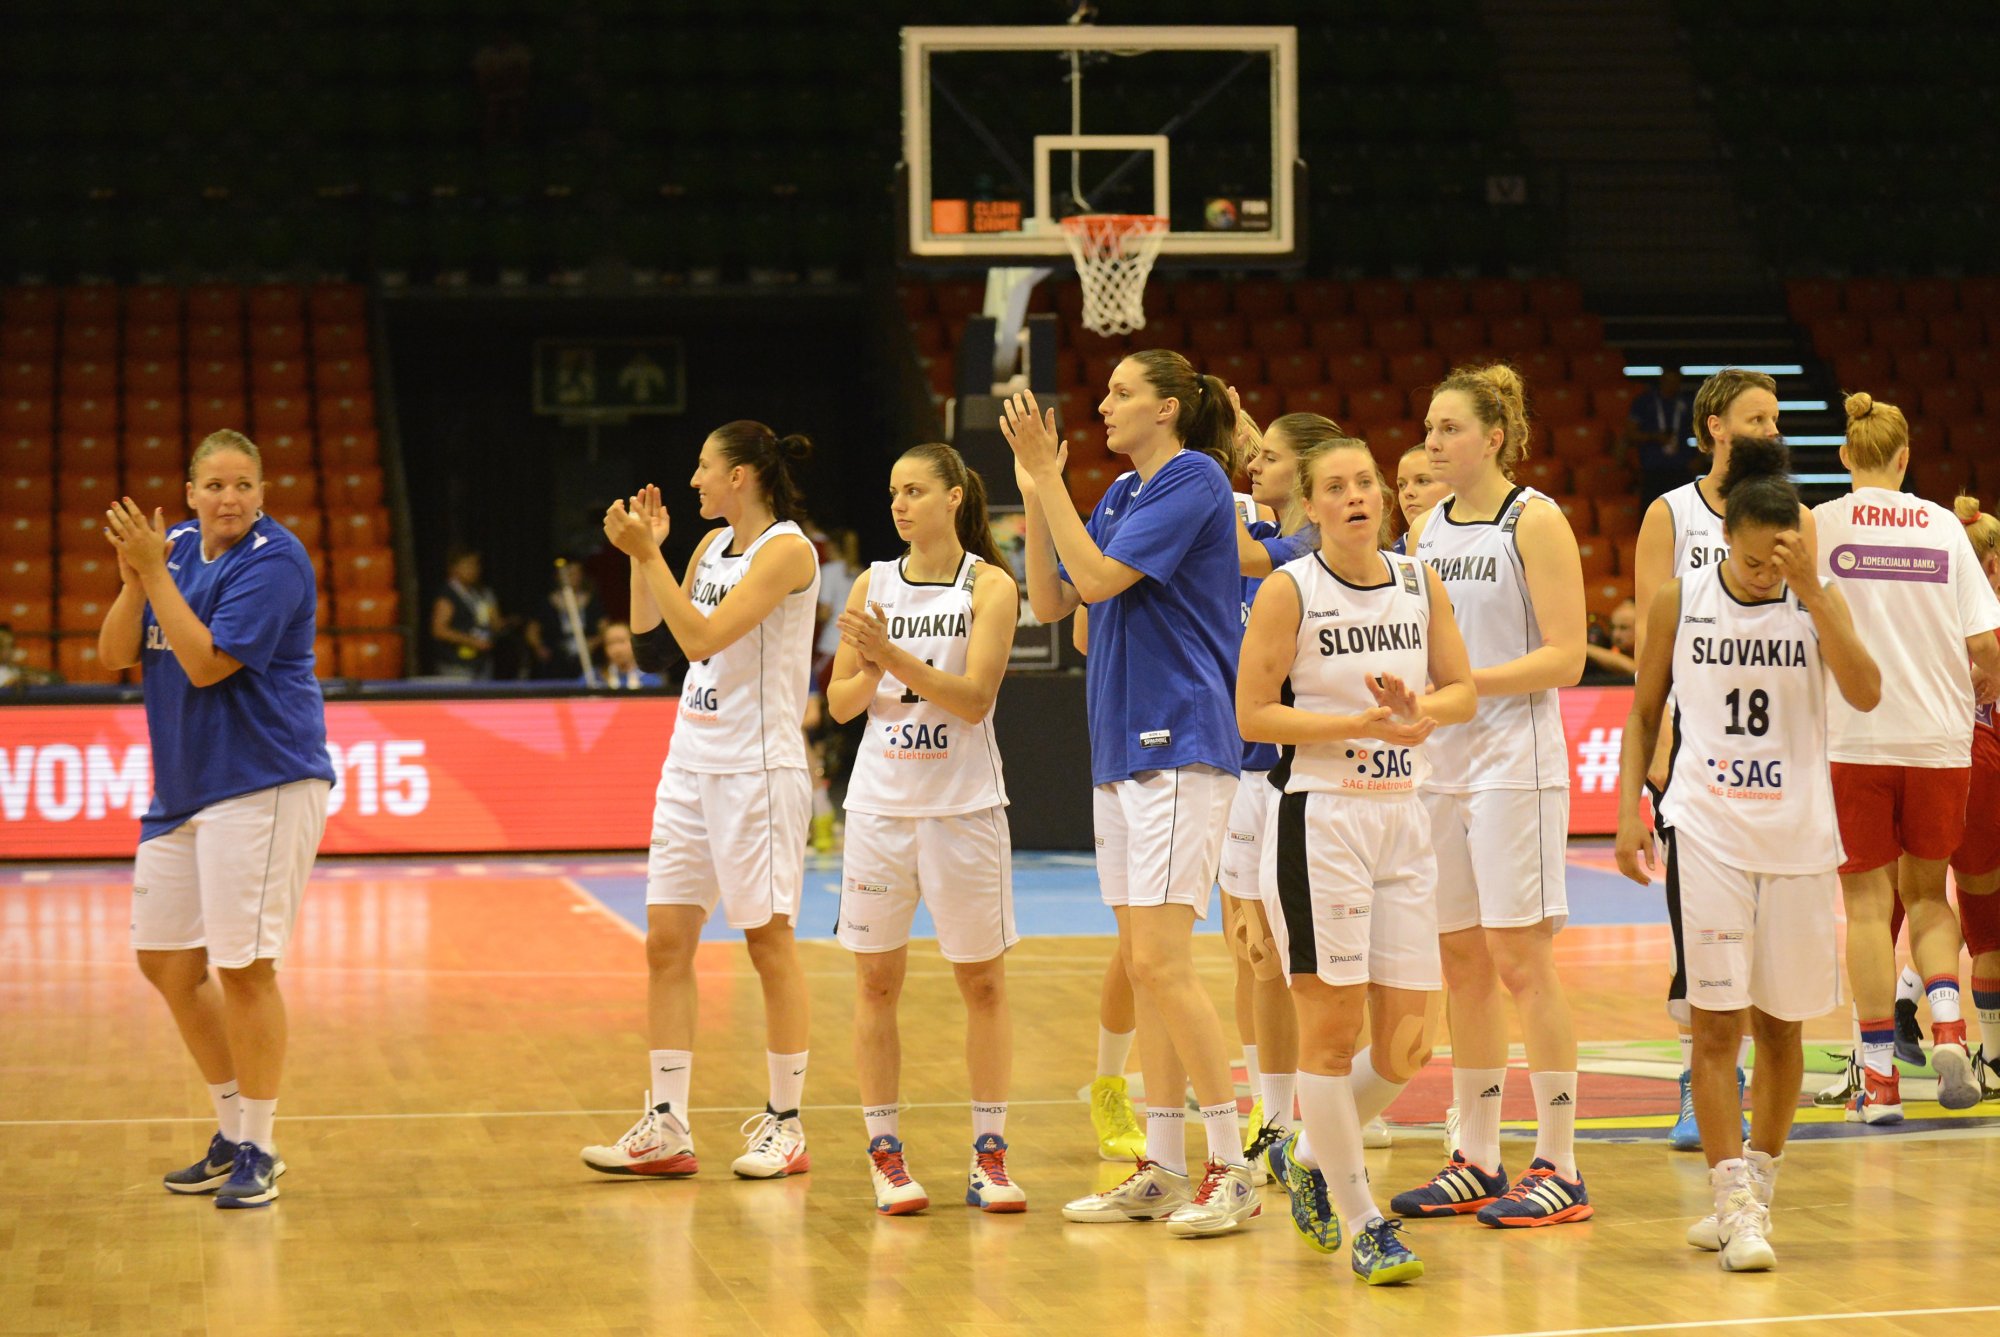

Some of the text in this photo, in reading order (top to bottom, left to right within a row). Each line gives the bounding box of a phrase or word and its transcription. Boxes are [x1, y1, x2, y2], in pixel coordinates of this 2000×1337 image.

[1852, 505, 1929, 528] KRNJIĆ
[1425, 556, 1497, 582] OVAKIA
[1862, 556, 1936, 569] KOMERCIJALNA BANKA
[1308, 609, 1339, 619] SPALDING
[1685, 616, 1716, 624] SPALDING
[887, 613, 967, 639] OVAKIA
[1318, 623, 1422, 656] SLOVAKIA
[1692, 636, 1807, 667] SLOVAKIA
[1725, 688, 1769, 737] 18
[901, 724, 948, 749] SAG
[897, 750, 948, 760] Elektrovod
[1371, 748, 1412, 778] SAG
[1342, 778, 1413, 791] SAG Elektrovod
[1730, 760, 1782, 788] SAG
[1727, 788, 1783, 800] Elektrovod
[1330, 953, 1362, 964] SPALDING
[1699, 979, 1732, 988] SPALDING
